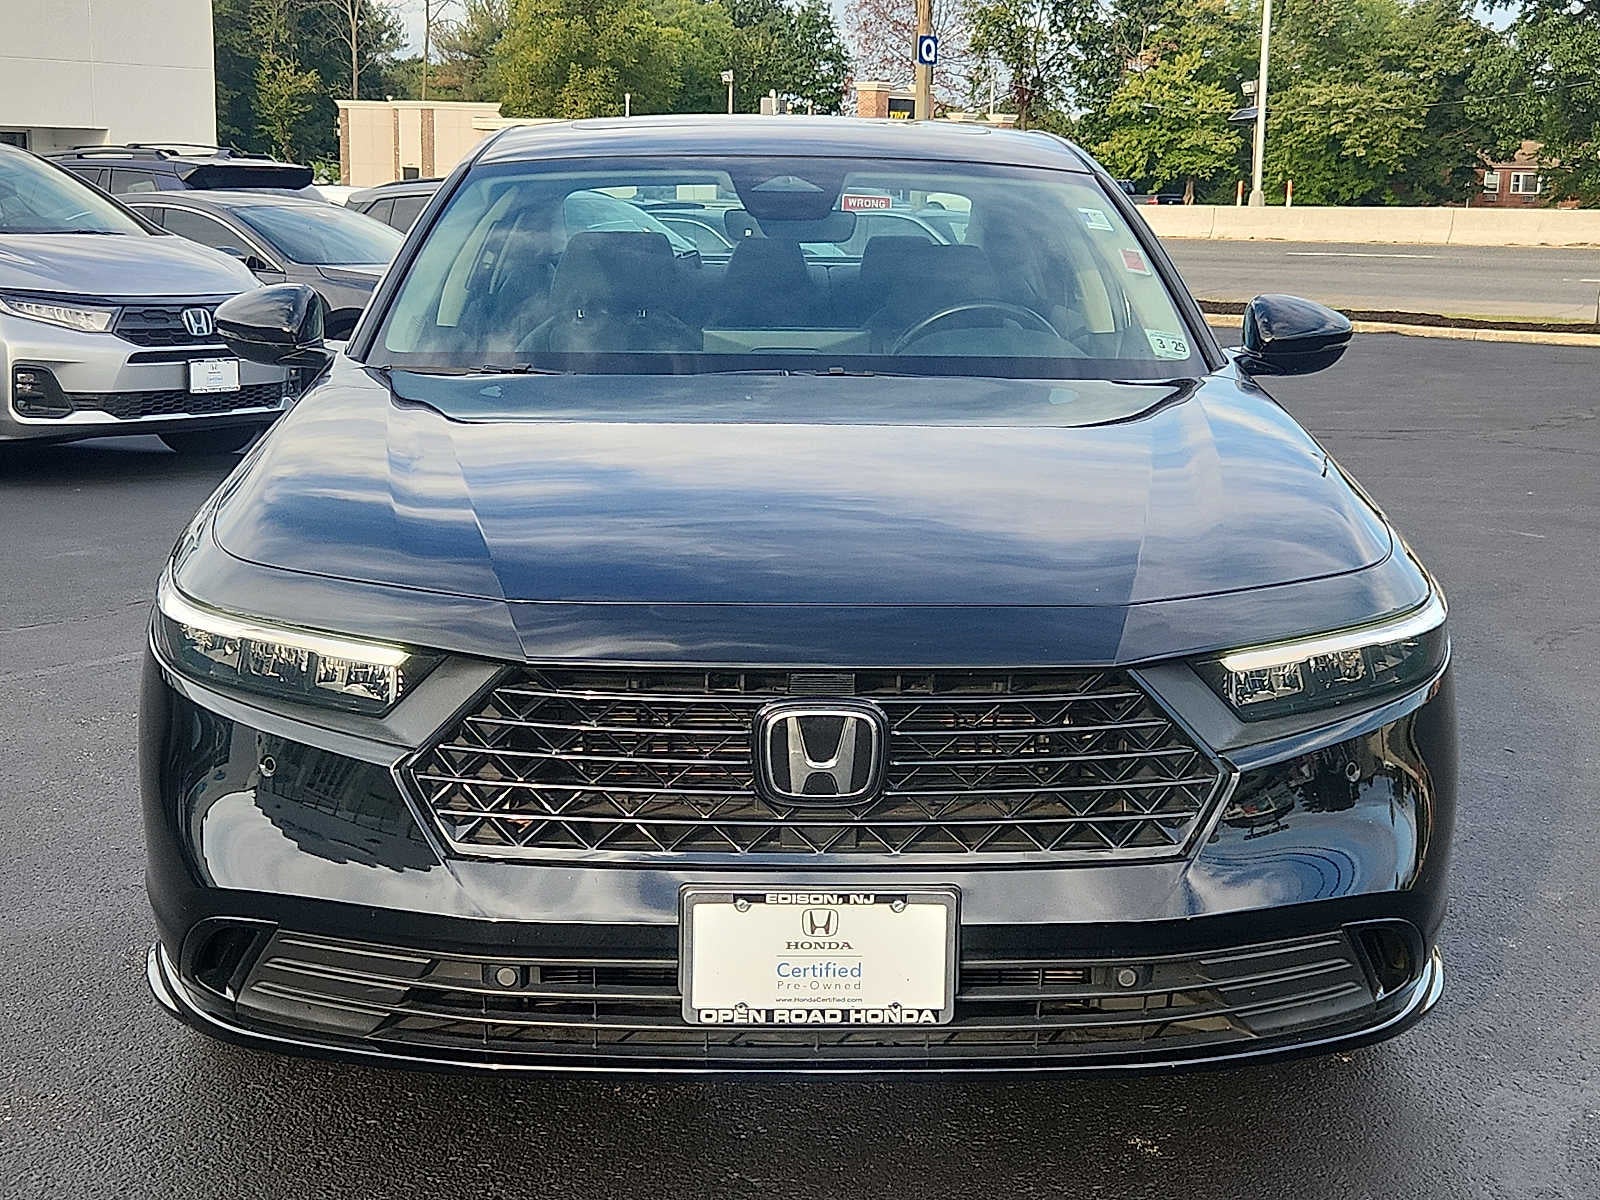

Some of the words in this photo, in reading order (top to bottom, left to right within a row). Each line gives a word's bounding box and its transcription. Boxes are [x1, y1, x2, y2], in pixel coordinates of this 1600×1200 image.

[921, 38, 936, 62] Q
[848, 198, 886, 209] WRONG
[1156, 338, 1166, 349] 3
[1171, 340, 1187, 353] 29
[765, 894, 843, 905] EDISON,
[849, 894, 875, 905] NJ
[785, 941, 855, 950] HONDA
[777, 962, 862, 978] Certified
[777, 980, 861, 990] Pre-Owned
[700, 1008, 767, 1024] OPEN
[774, 1008, 843, 1024] ROAD
[850, 1008, 937, 1024] HONDA
